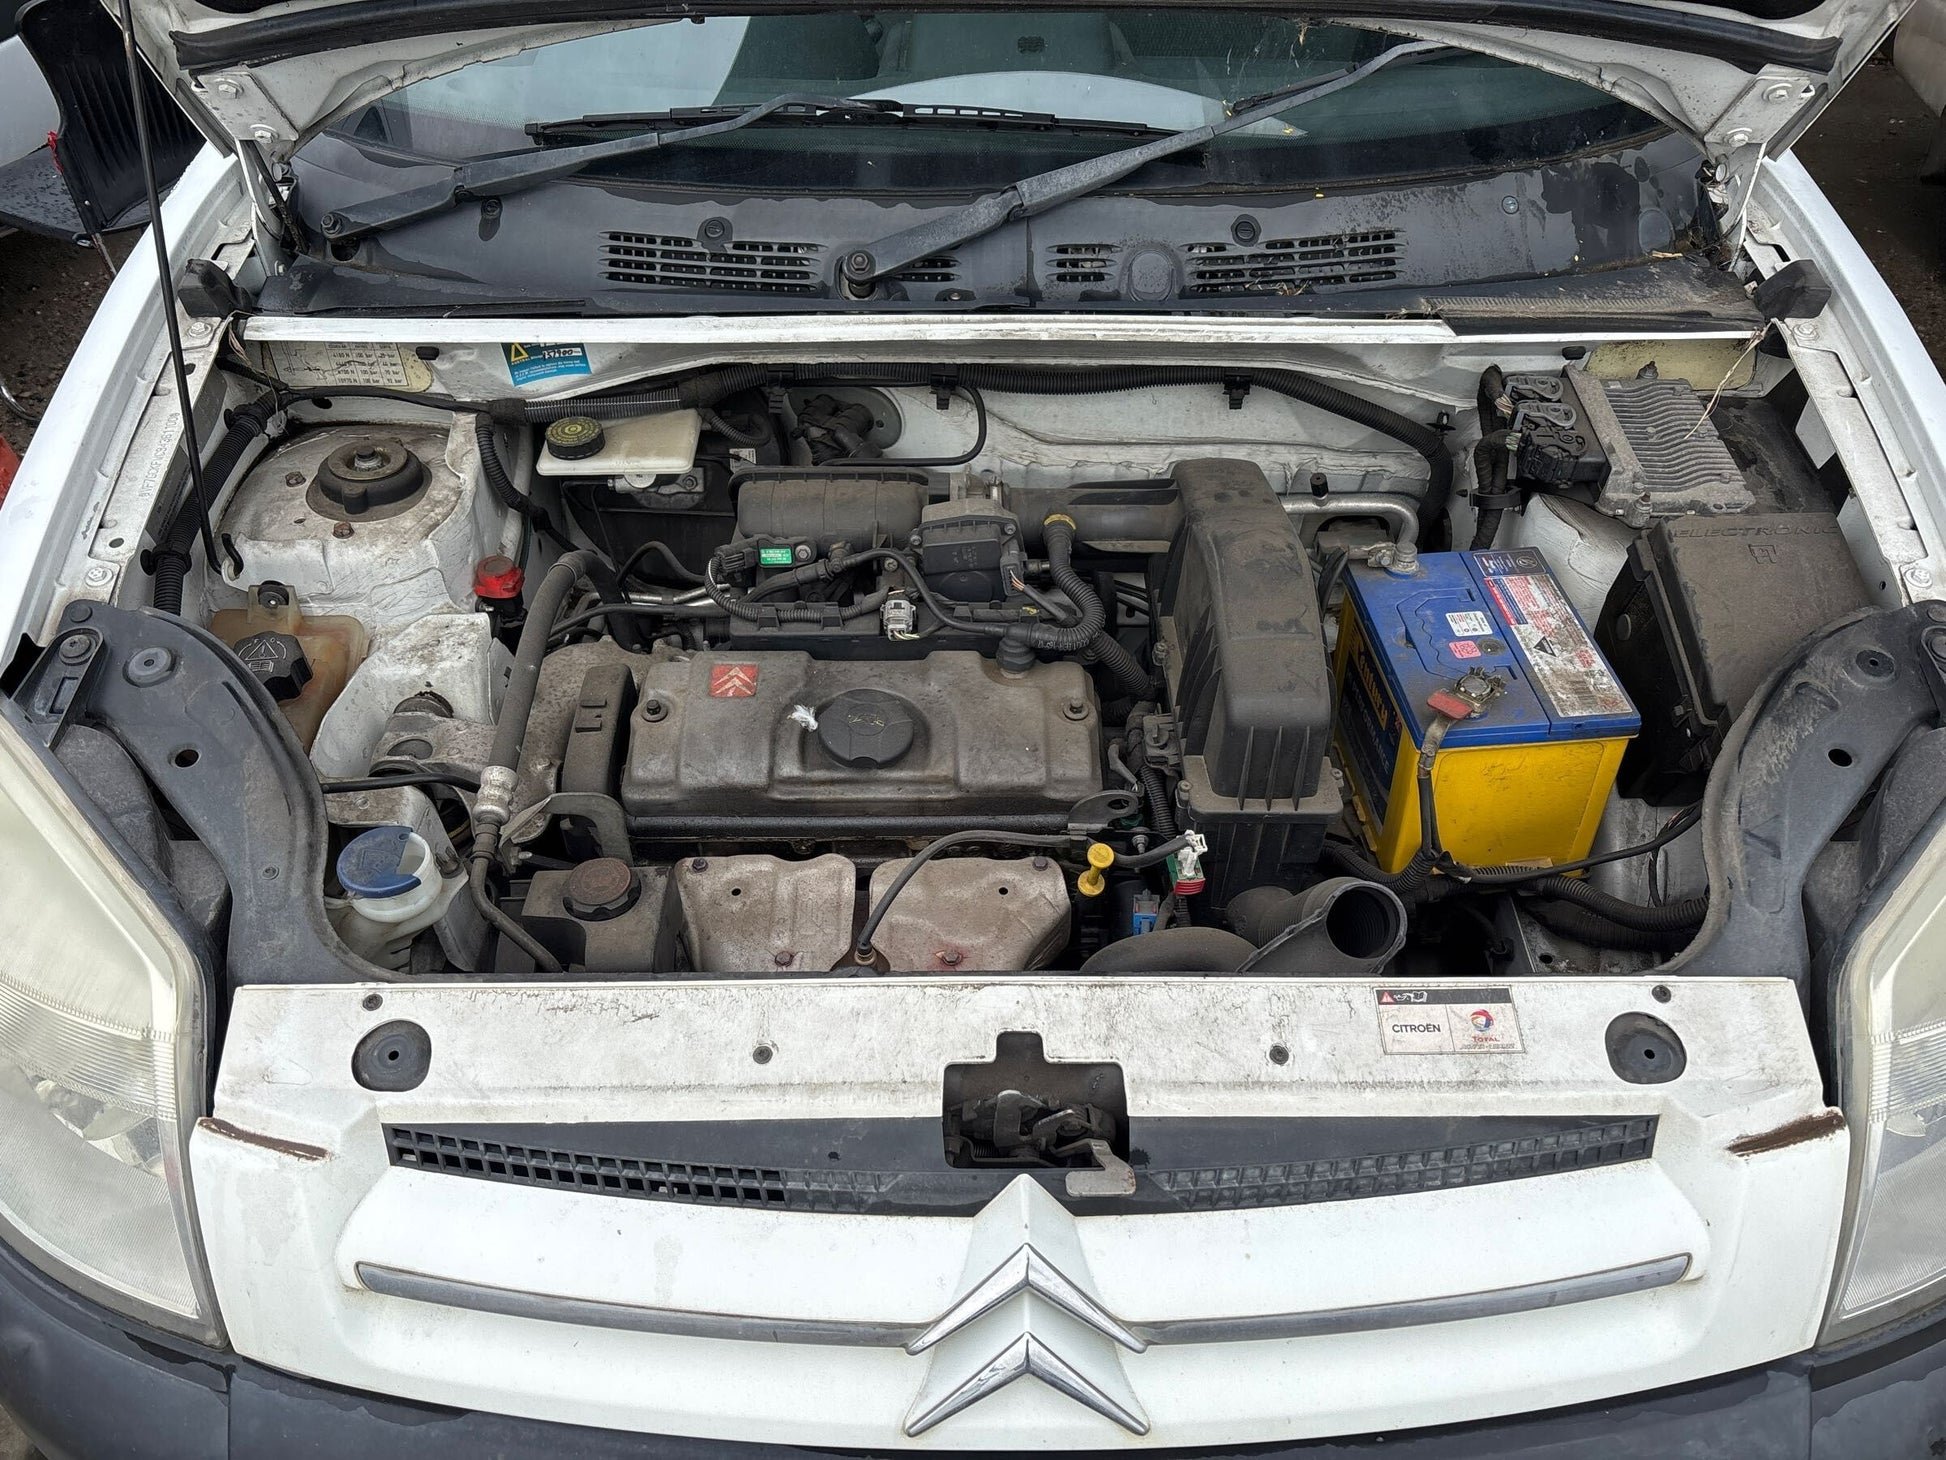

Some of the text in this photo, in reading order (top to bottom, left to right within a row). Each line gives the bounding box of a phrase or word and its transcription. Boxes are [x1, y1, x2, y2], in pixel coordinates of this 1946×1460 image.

[1674, 525, 1839, 538] ELECTRONIC
[1391, 1022, 1441, 1033] CITROËN
[1471, 1035, 1500, 1043] TOTAL
